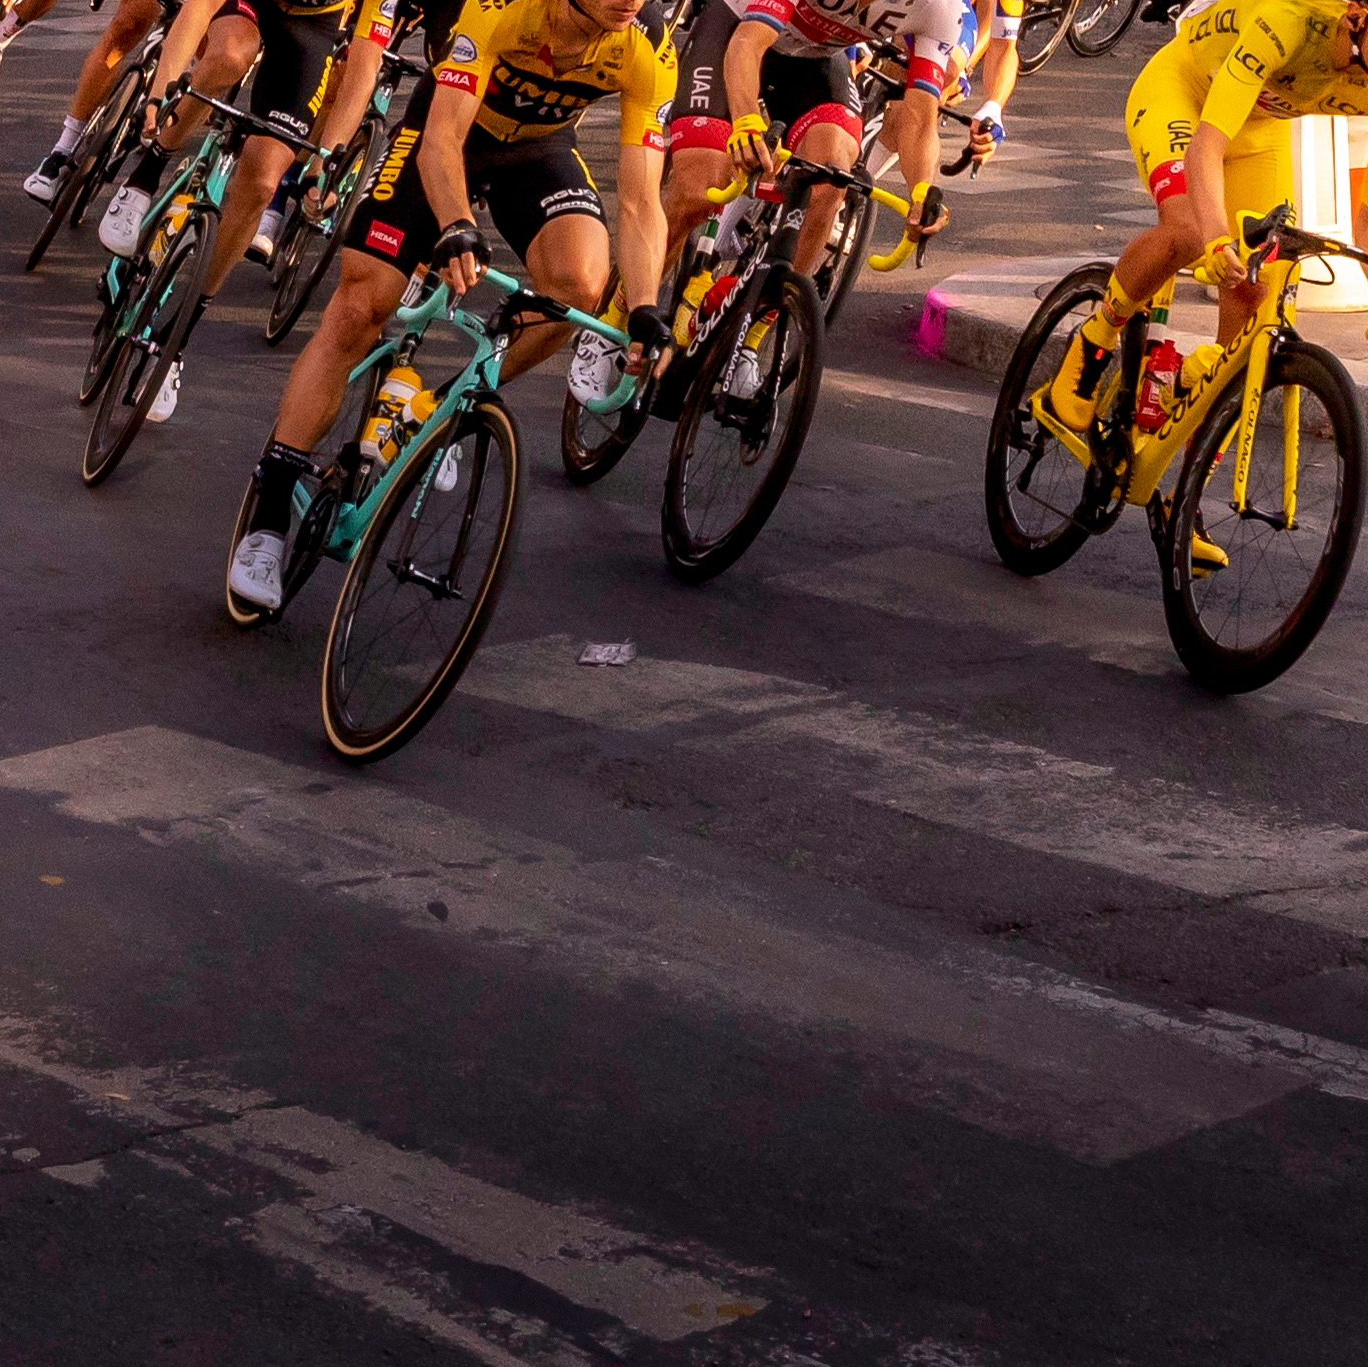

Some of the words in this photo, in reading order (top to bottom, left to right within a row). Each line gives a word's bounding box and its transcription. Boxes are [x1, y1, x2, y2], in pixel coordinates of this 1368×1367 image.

[438, 69, 471, 87] EMA
[1234, 45, 1266, 80] LCL
[690, 67, 713, 109] UAE
[649, 134, 664, 148] HE
[1168, 120, 1191, 153] UAE
[373, 126, 421, 201] JUMBO
[546, 200, 600, 217] Bianchi
[370, 229, 399, 248] HEMA
[686, 242, 769, 357] COLNAGO
[722, 322, 749, 392] COLNAGO
[1158, 316, 1257, 441] COLNAGO
[1238, 396, 1260, 483] COLNAGO
